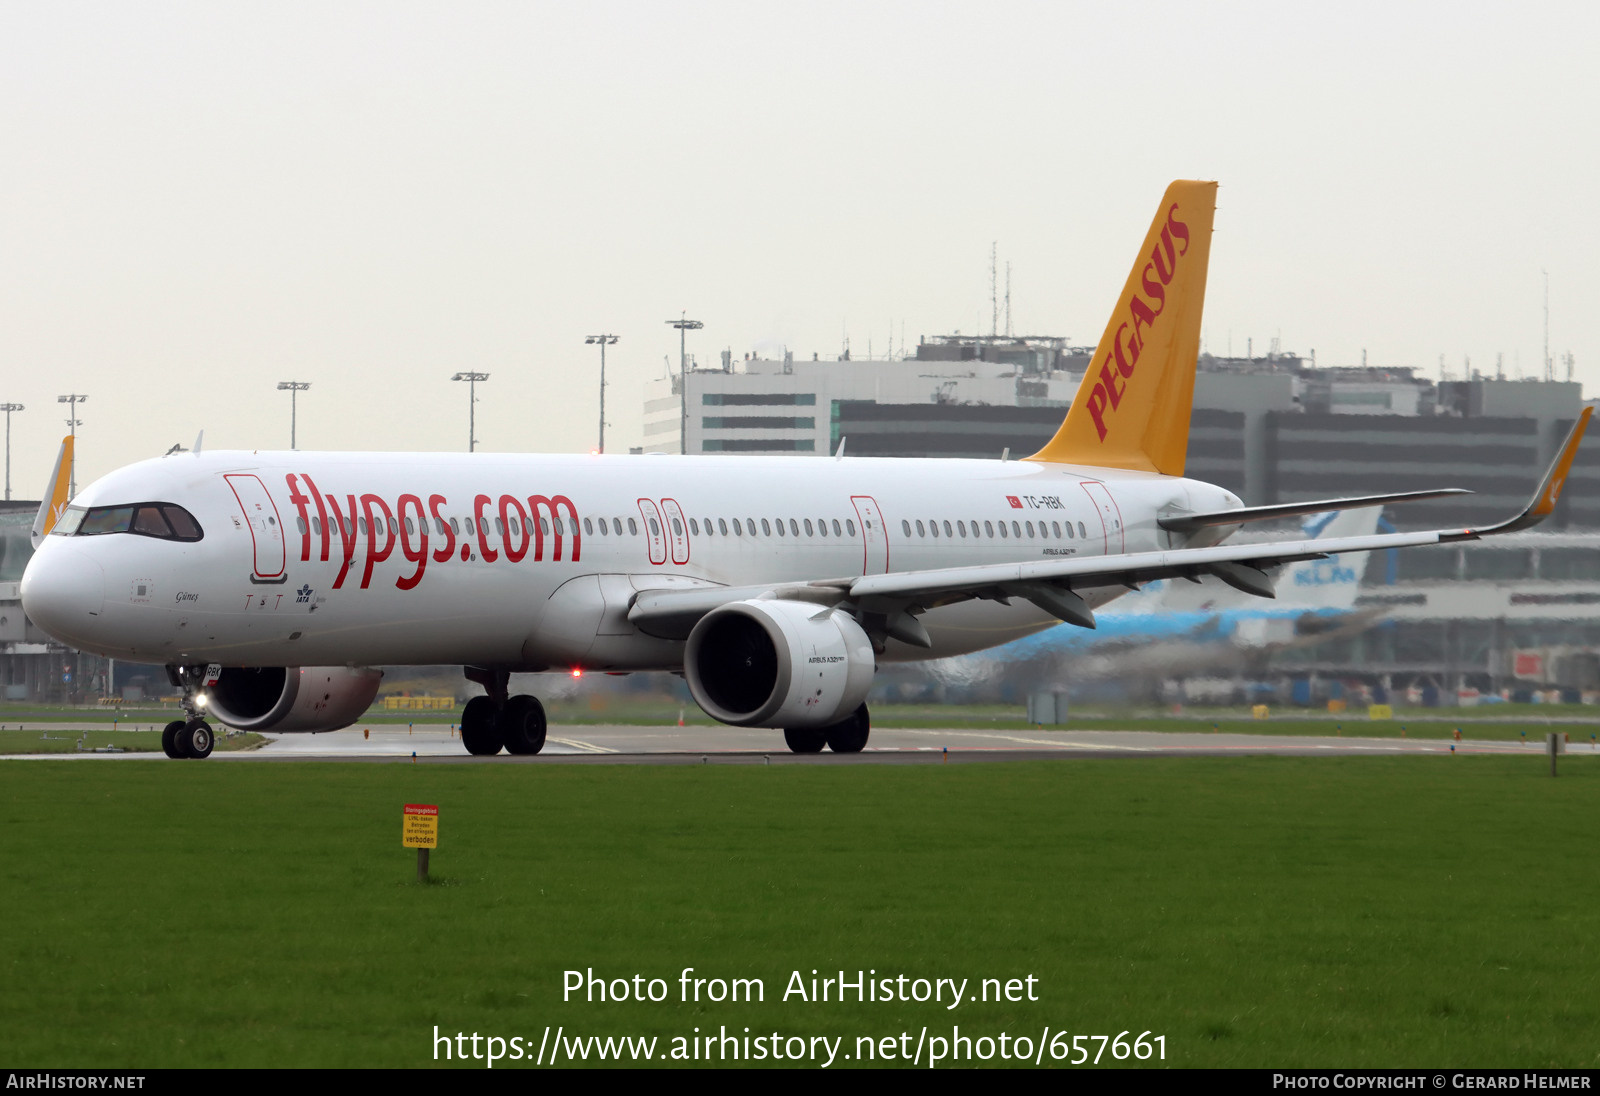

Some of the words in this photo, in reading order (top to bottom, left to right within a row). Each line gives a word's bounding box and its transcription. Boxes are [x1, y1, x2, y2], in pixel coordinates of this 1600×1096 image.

[1085, 202, 1190, 444] PEGASUS
[1023, 495, 1066, 510] TC-RBK
[284, 472, 581, 590] flypgs.com
[1294, 567, 1355, 586] KLM
[207, 666, 221, 677] RBK
